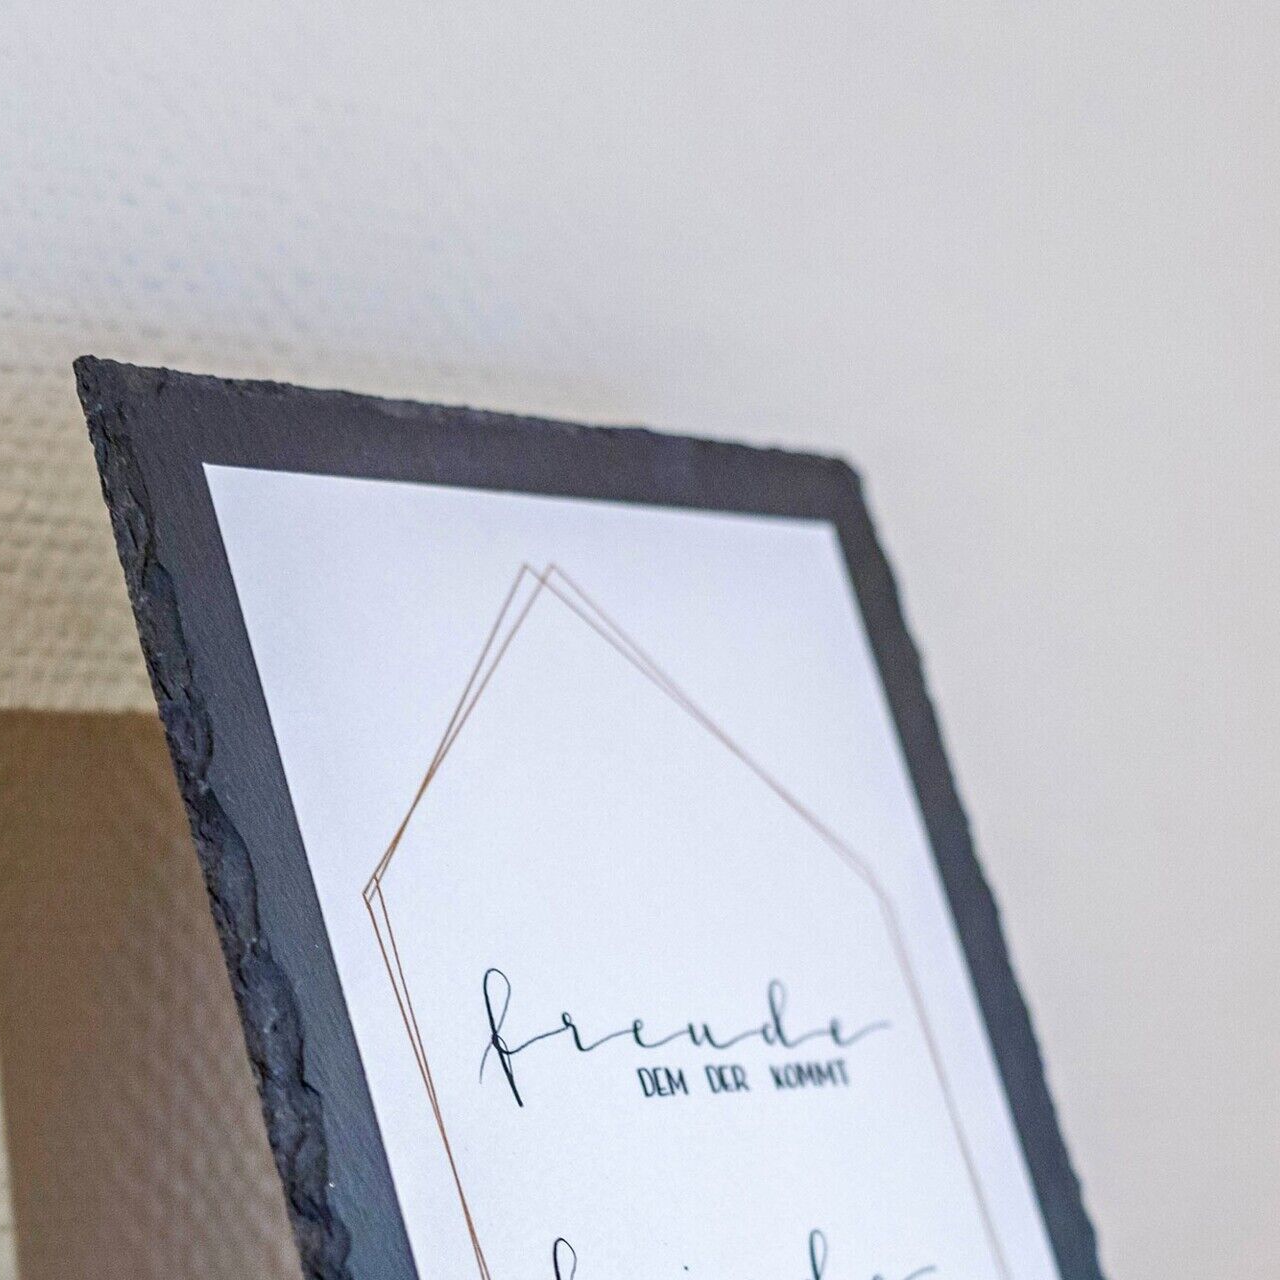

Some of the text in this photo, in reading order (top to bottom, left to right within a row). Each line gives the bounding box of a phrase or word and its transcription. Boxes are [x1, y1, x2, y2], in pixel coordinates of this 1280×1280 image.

[479, 967, 892, 1108] freude
[637, 1058, 850, 1099] DEM DER KOMMT
